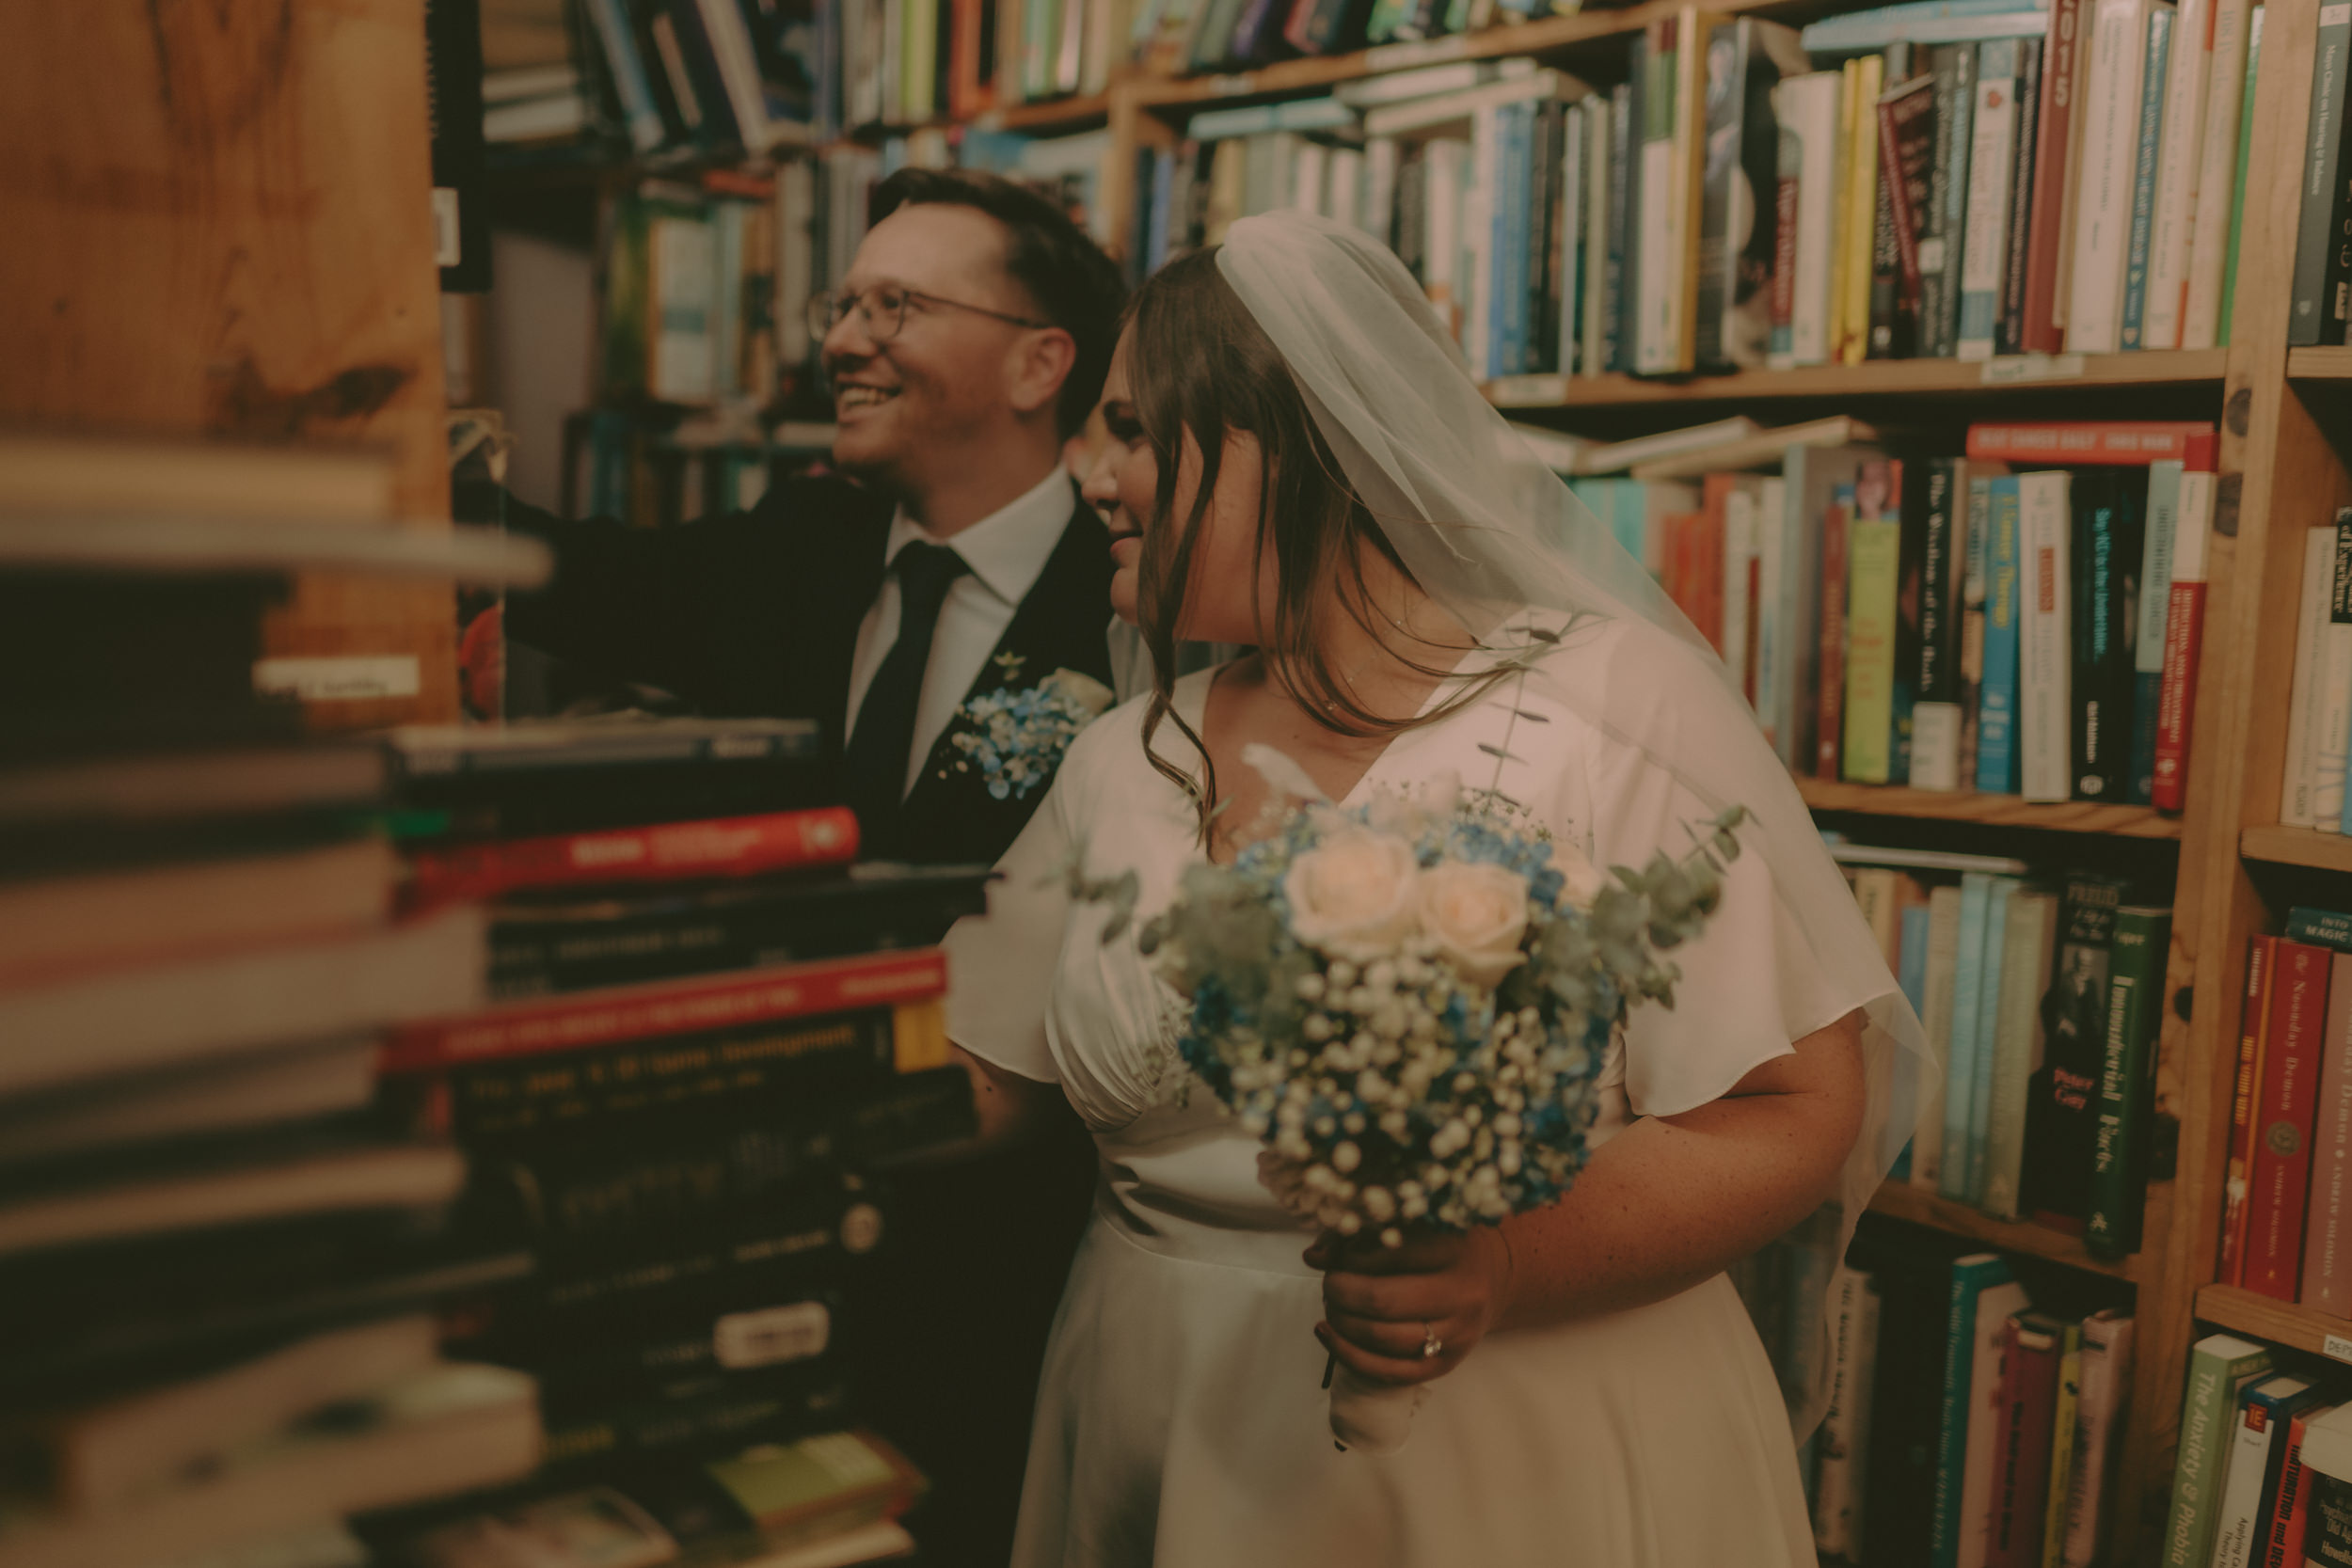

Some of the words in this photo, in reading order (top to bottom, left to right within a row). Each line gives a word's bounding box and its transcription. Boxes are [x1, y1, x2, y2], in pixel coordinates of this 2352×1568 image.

[2324, 45, 2338, 71] Mayo
[2321, 71, 2333, 98] Clinic
[2311, 160, 2326, 196] Balance
[2305, 925, 2349, 942] MAGIC
[2321, 916, 2348, 929] INTO
[2286, 980, 2307, 1049] Noonday
[2054, 1066, 2095, 1091] Peter
[2280, 1056, 2300, 1112] Demon
[2328, 1165, 2344, 1215] ANDREW
[2322, 1218, 2339, 1278] SOLOMON
[2196, 1372, 2217, 1407] The
[2182, 1407, 2210, 1480] Anxiety
[2182, 1482, 2200, 1502] &
[2171, 1503, 2197, 1565] Phobia
[2219, 1531, 2233, 1559] Theory
[2233, 1517, 2249, 1555] Applying
[2273, 1523, 2287, 1545] and
